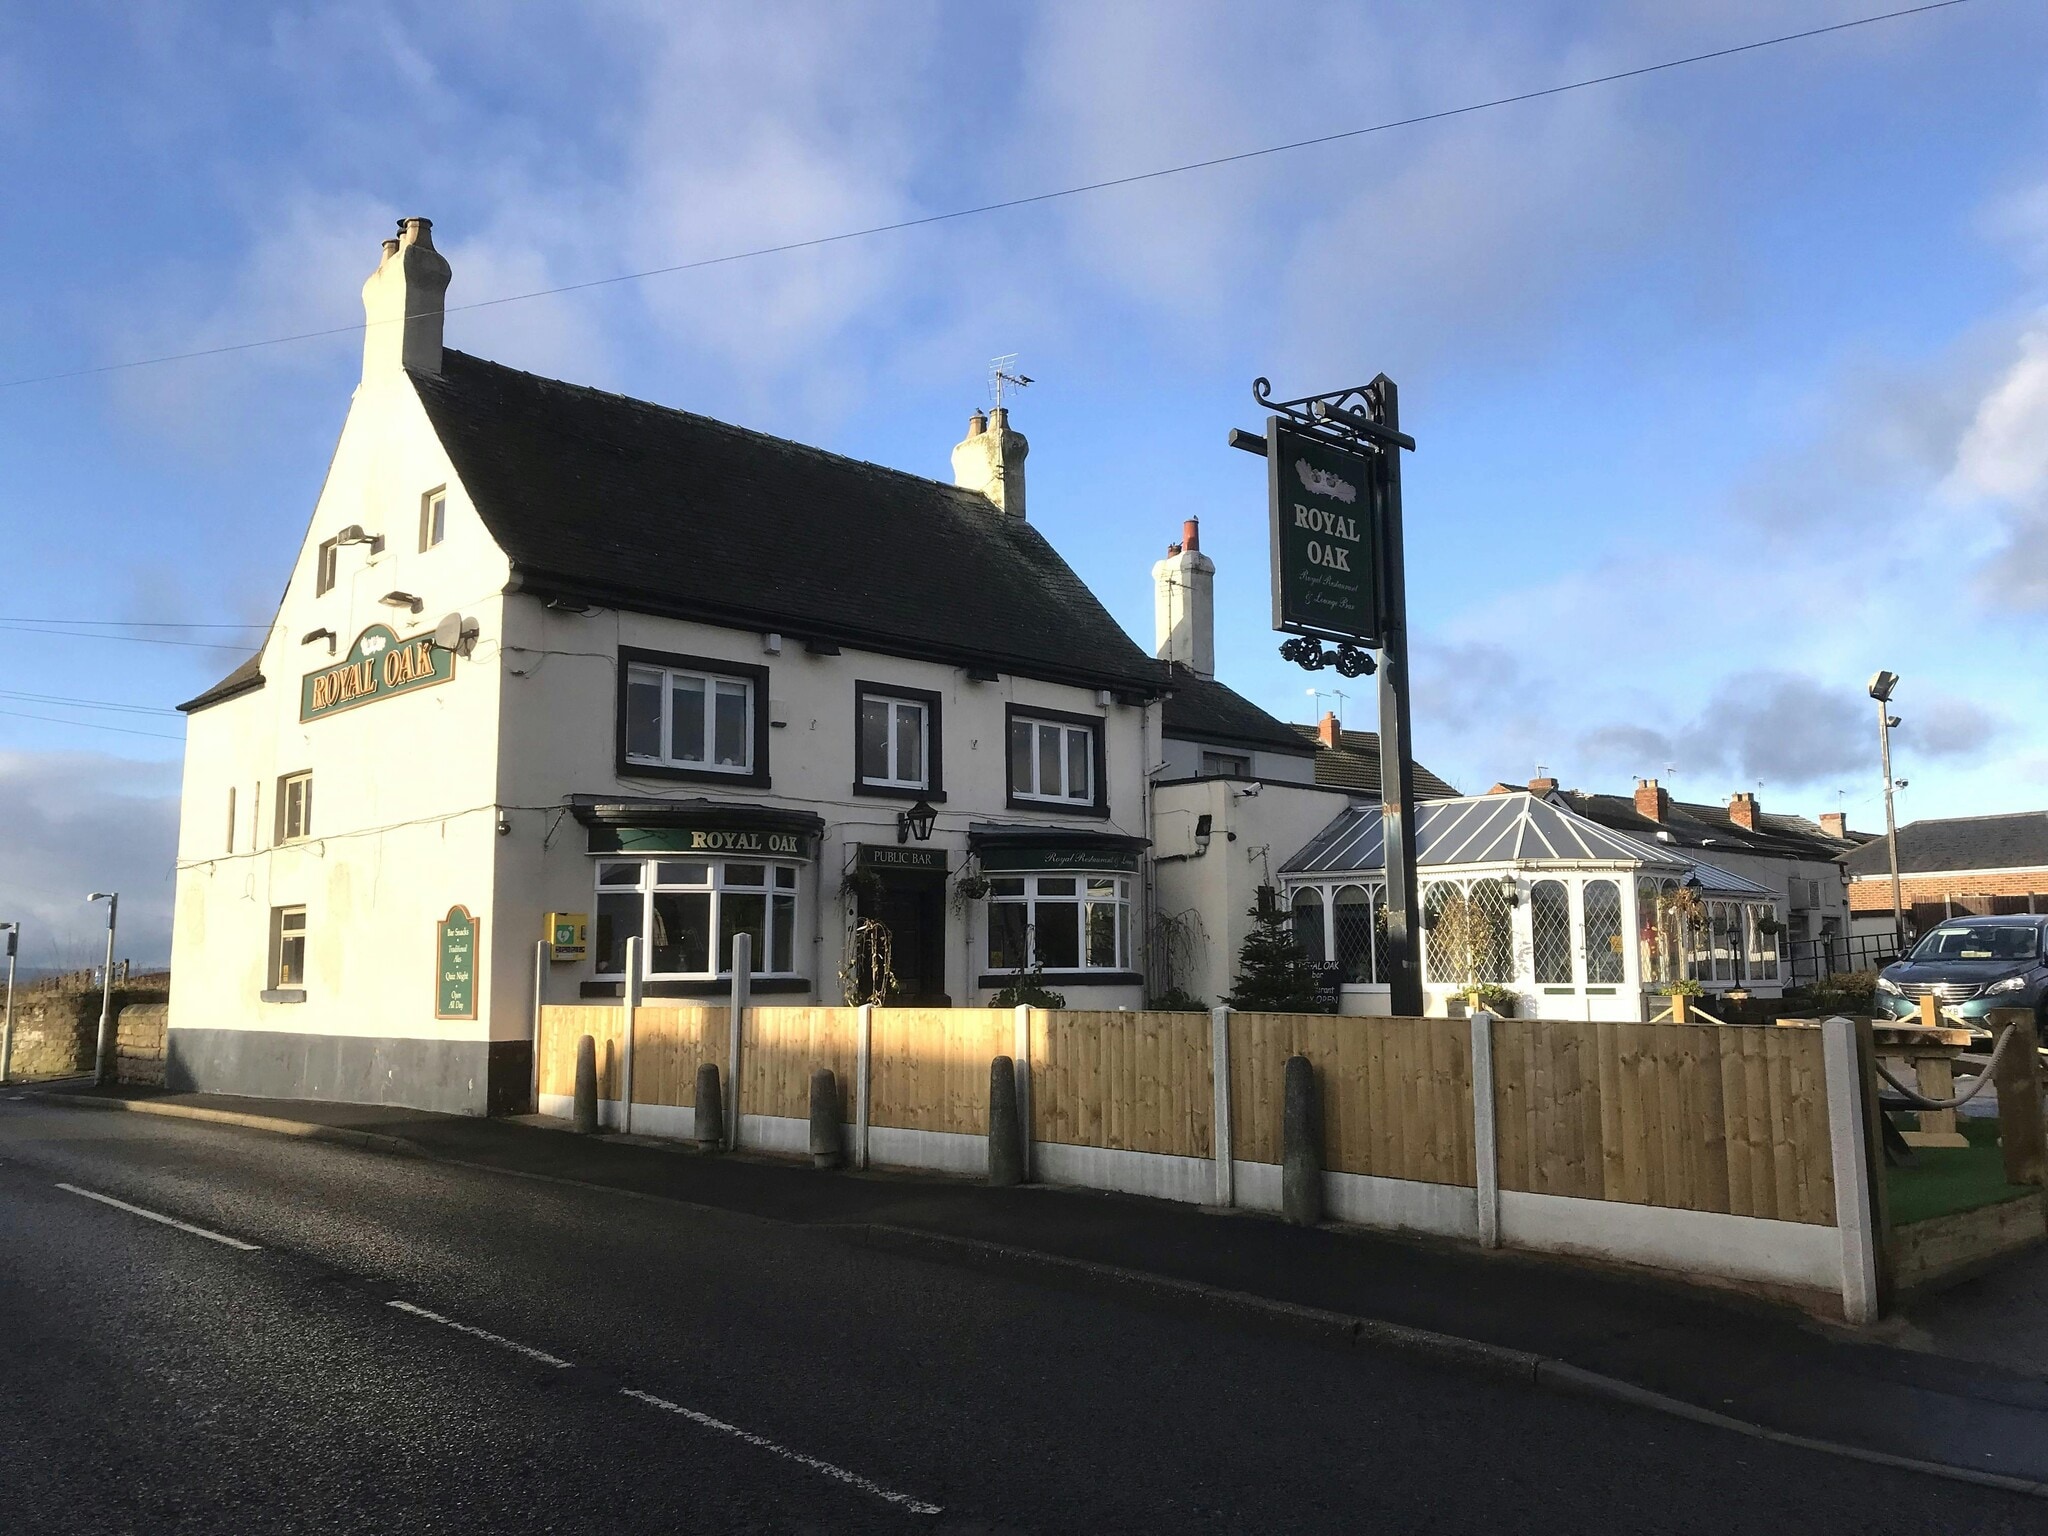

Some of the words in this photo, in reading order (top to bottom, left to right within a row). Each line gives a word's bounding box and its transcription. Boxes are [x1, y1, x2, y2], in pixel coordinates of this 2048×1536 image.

[1294, 503, 1361, 542] ROYAL
[1307, 540, 1350, 572] OAK
[311, 658, 378, 711] ROYAL
[384, 639, 435, 688] OAK
[690, 831, 762, 850] ROYAL
[768, 834, 798, 853] OAK
[874, 851, 909, 863] PUBLIC
[912, 853, 932, 865] BAR
[1044, 853, 1073, 866] Royal
[1323, 961, 1339, 970] OAK
